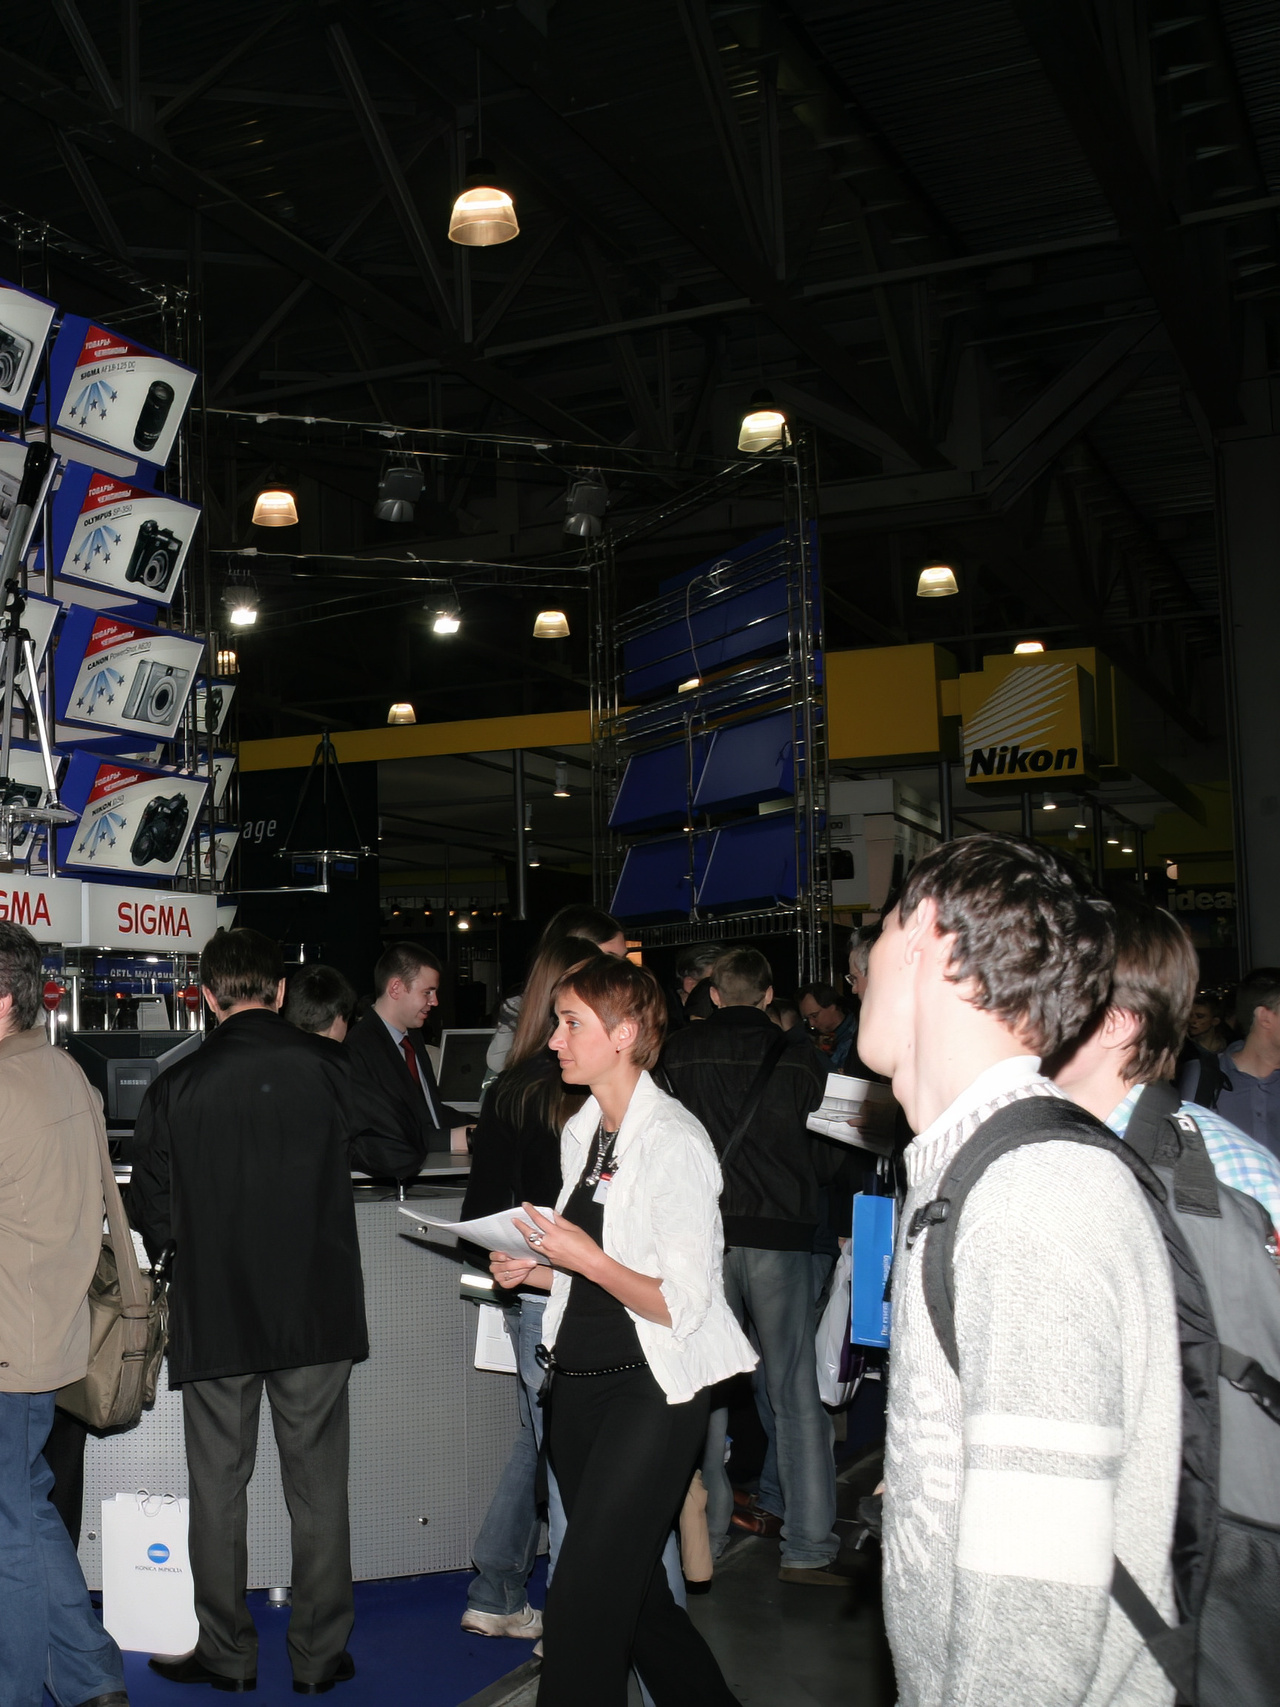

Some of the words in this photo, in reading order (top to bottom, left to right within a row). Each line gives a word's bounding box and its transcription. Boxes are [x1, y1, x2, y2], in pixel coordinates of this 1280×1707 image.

[80, 368, 100, 380] SIGMA
[83, 510, 112, 527] OLYMPUS
[87, 655, 108, 671] CANON
[968, 745, 1078, 778] Nikon
[92, 800, 112, 816] NIKON
[243, 820, 277, 843] age
[1168, 888, 1237, 910] idea
[118, 902, 192, 938] SIGMA
